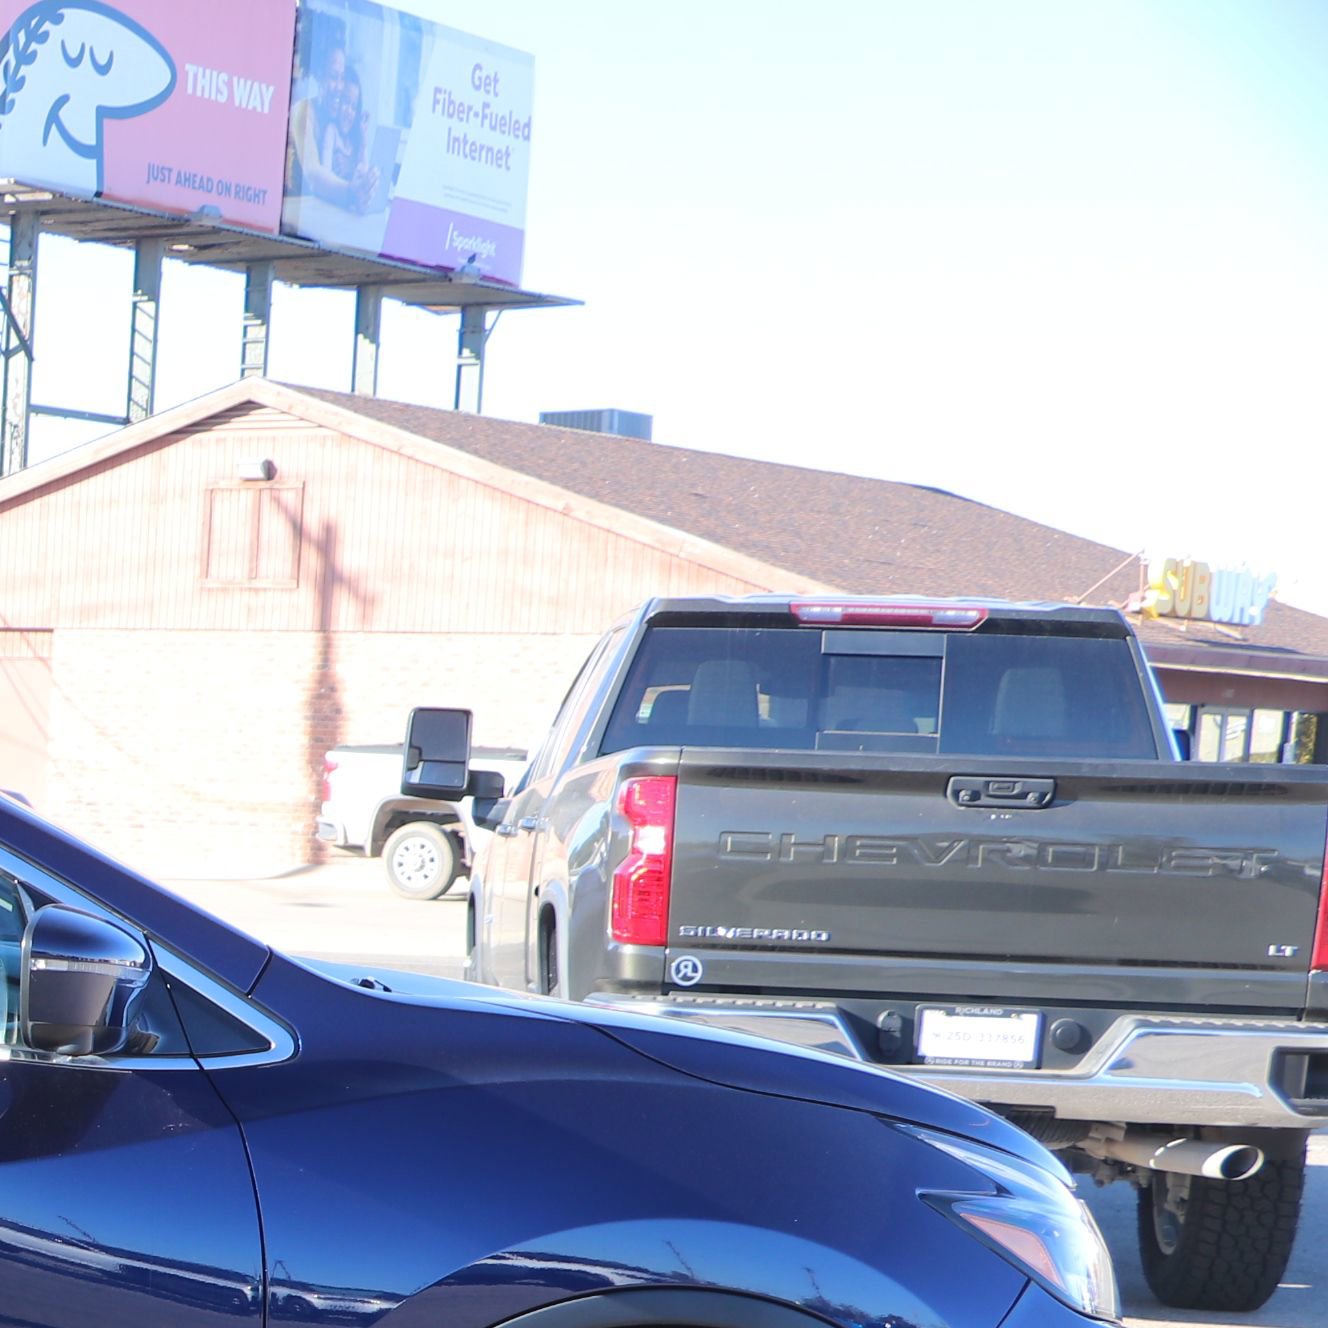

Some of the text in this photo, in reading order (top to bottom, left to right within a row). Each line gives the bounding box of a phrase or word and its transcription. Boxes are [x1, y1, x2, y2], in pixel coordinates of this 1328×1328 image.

[185, 63, 275, 114] THIS WAY
[471, 62, 499, 98] Get
[432, 86, 532, 142] Fiber-Fueled
[446, 126, 511, 171] Internet
[146, 162, 268, 206] JUST AHEAD ON RIGHT
[1146, 558, 1278, 625] SUBWAY
[718, 830, 1280, 879] CHEVROLET
[679, 925, 832, 942] SILVERADO
[1268, 944, 1299, 957] LT
[954, 1006, 1004, 1017] RICHLAND
[935, 1057, 953, 1066] RIDE
[953, 1058, 970, 1067] FOR
[971, 1059, 986, 1067] THE
[986, 1060, 1013, 1069] BRAND
